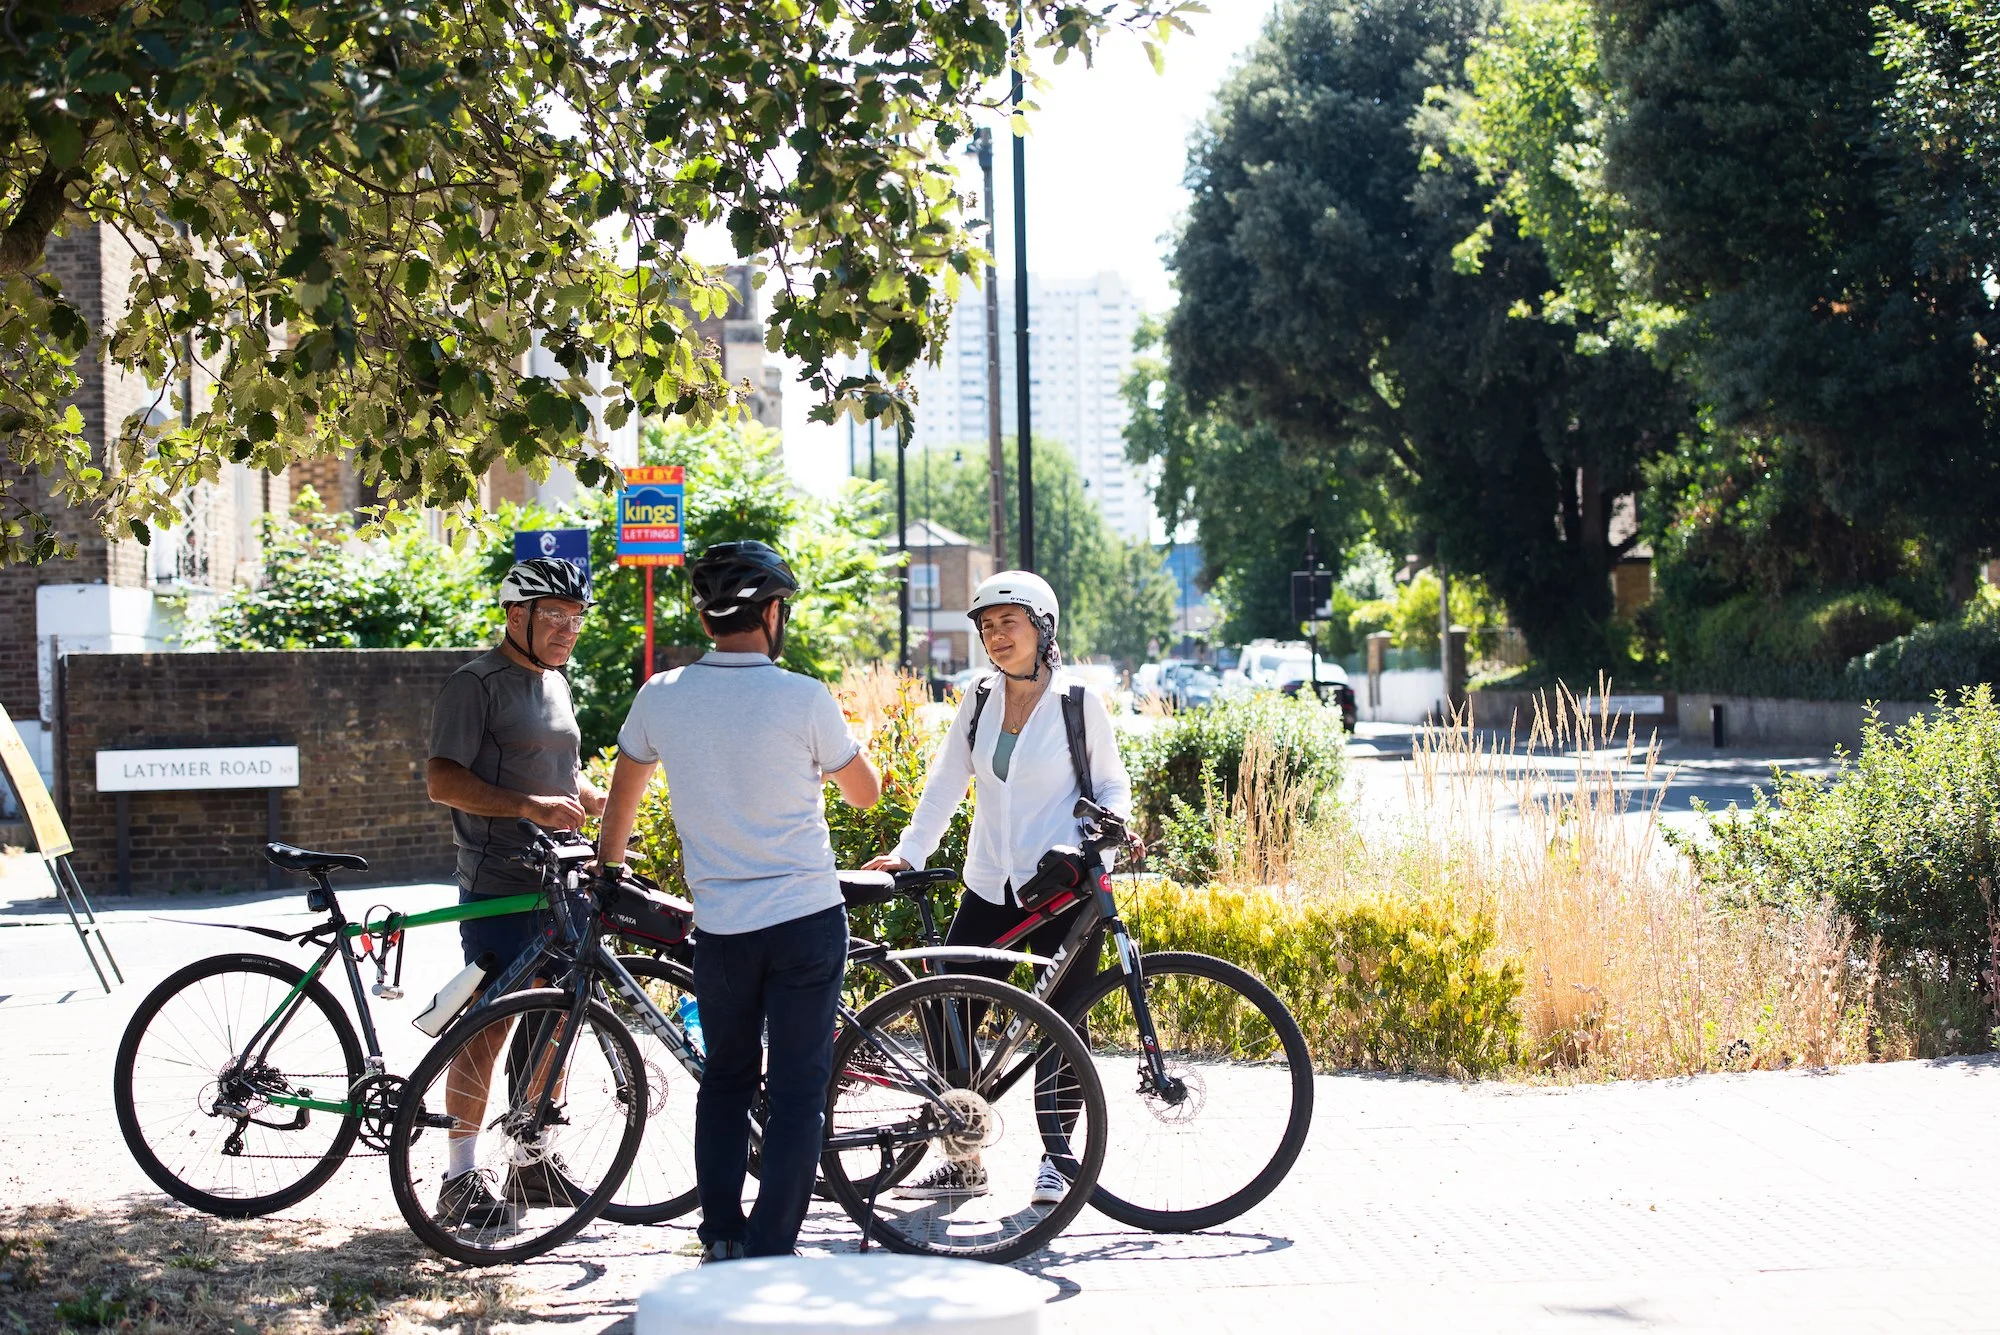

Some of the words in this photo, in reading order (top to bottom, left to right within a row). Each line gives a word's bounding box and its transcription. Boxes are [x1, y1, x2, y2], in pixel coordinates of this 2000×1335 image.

[624, 469, 649, 481] LET
[653, 468, 674, 480] BY
[624, 499, 676, 526] kings
[624, 529, 676, 540] LETTINGS
[123, 762, 212, 779] LATYMER
[219, 760, 273, 776] ROAD
[614, 975, 704, 1081] TREK
[608, 1030, 638, 1128] BONTRAGER
